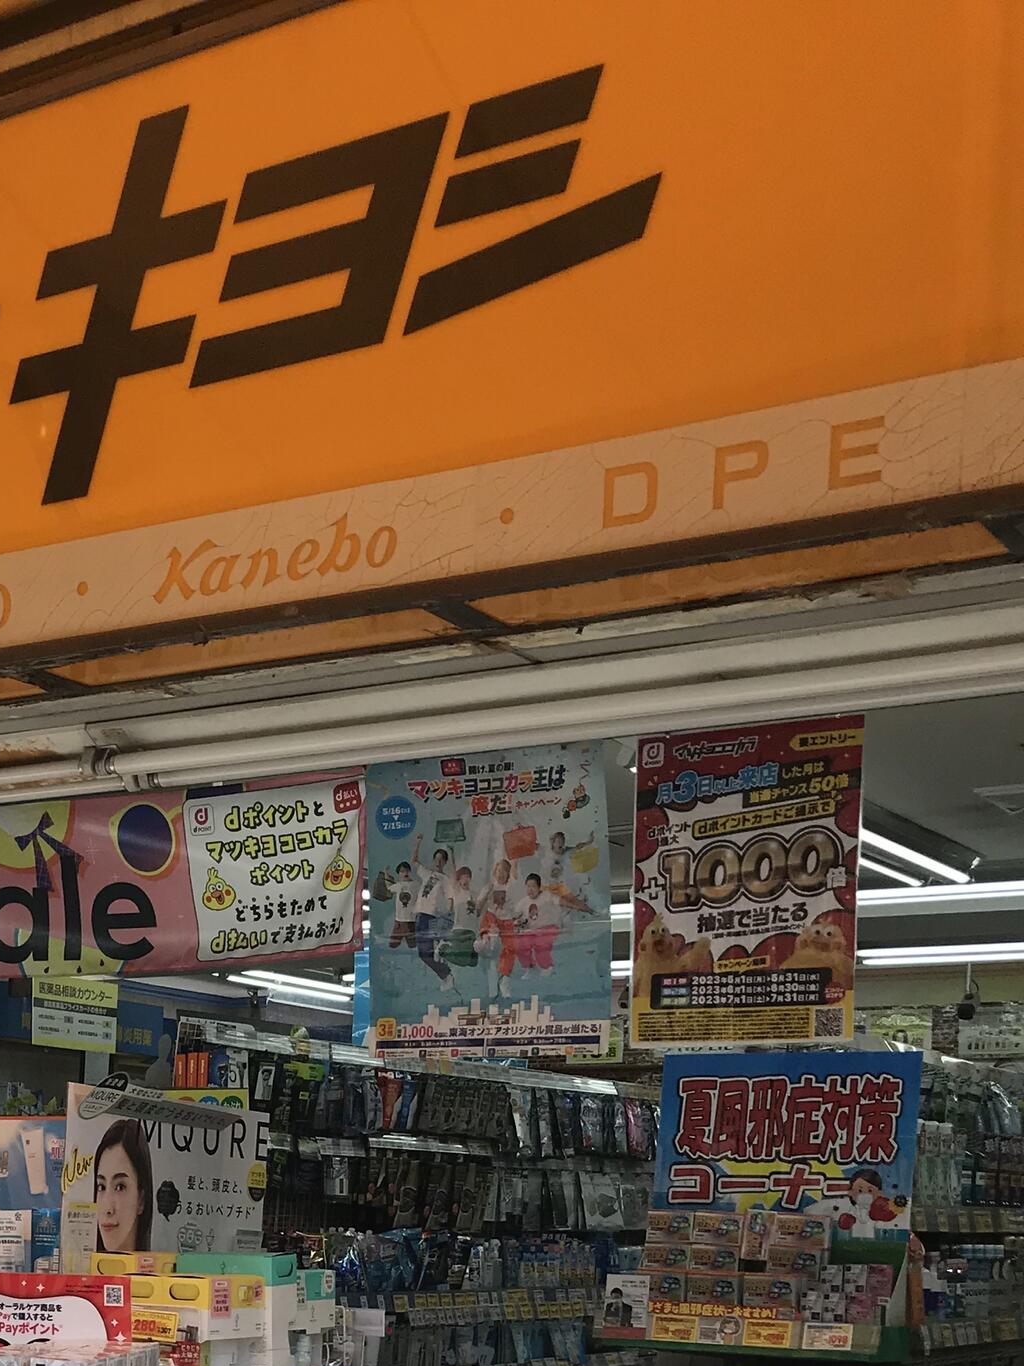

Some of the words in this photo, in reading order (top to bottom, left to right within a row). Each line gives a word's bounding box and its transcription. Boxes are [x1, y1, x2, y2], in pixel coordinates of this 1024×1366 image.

[153, 512, 398, 605] Kanebo
[224, 800, 325, 832] dポイントと
[206, 819, 349, 864] マツキヨココカラ
[250, 859, 315, 886] ポイント
[235, 900, 328, 922] どちらもためて
[697, 902, 809, 934] 抽選で当たる
[38, 981, 113, 1003] 医薬品相談カウンター
[675, 1073, 903, 1163] 夏風邪症対策
[137, 1118, 271, 1162] MQURE
[62, 1148, 94, 1190] New
[668, 1162, 853, 1210] コーナー
